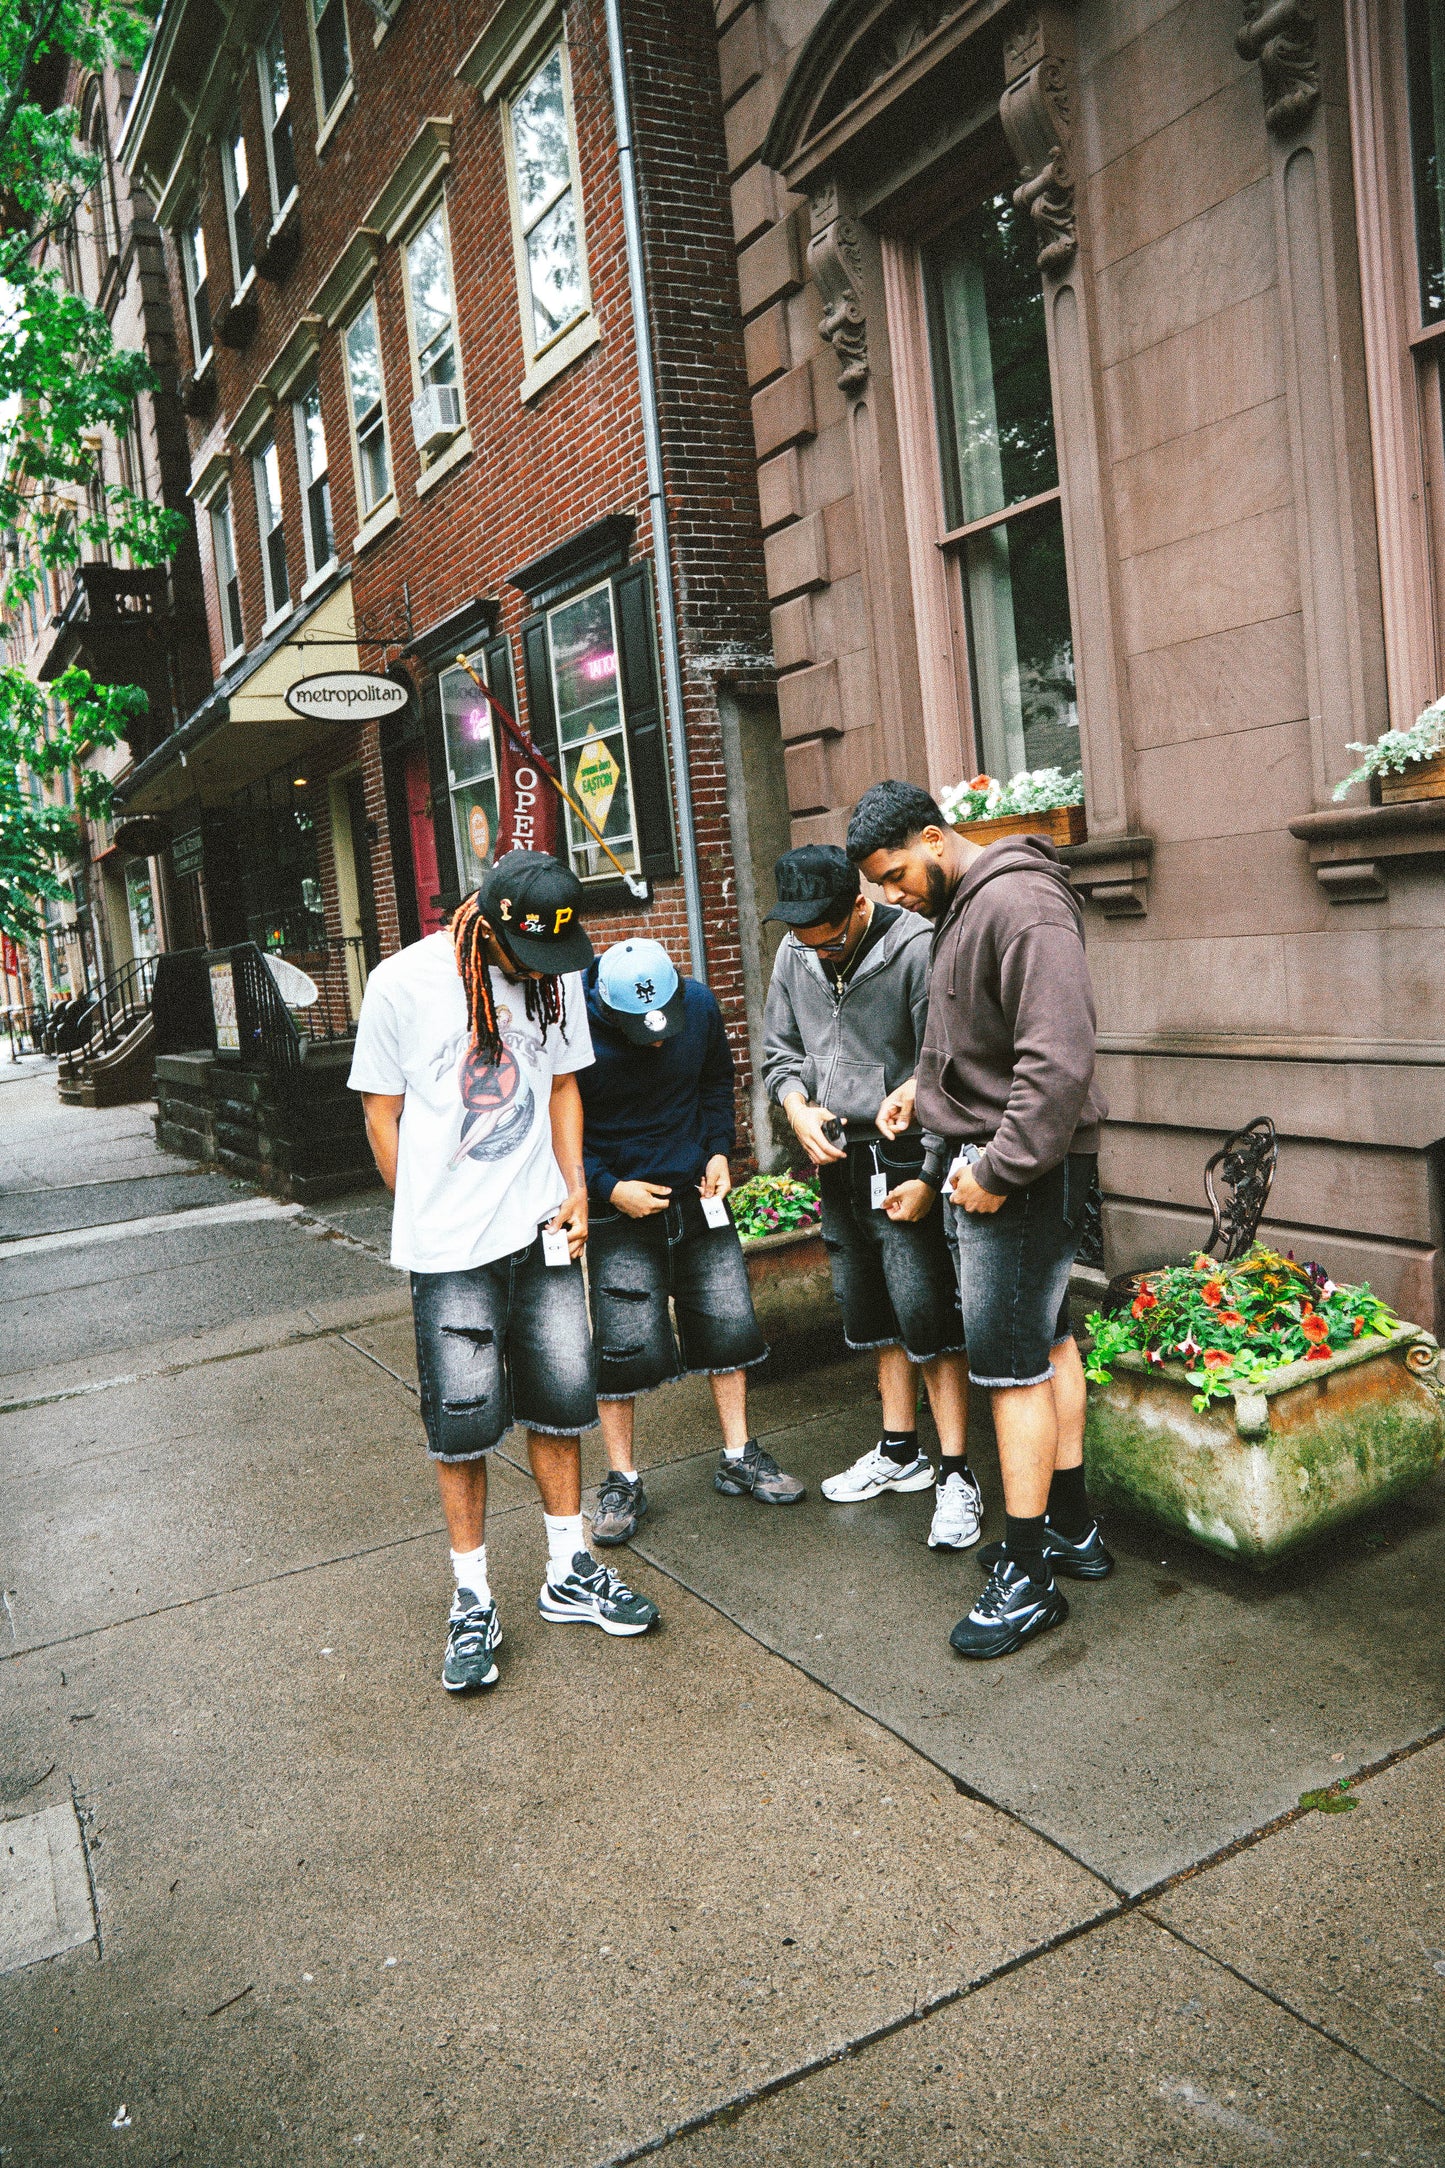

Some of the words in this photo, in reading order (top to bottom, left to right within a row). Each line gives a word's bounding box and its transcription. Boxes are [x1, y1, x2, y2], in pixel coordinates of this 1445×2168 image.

[296, 685, 402, 707] metropolitan
[582, 772, 613, 795] EASTON
[553, 906, 573, 934] P
